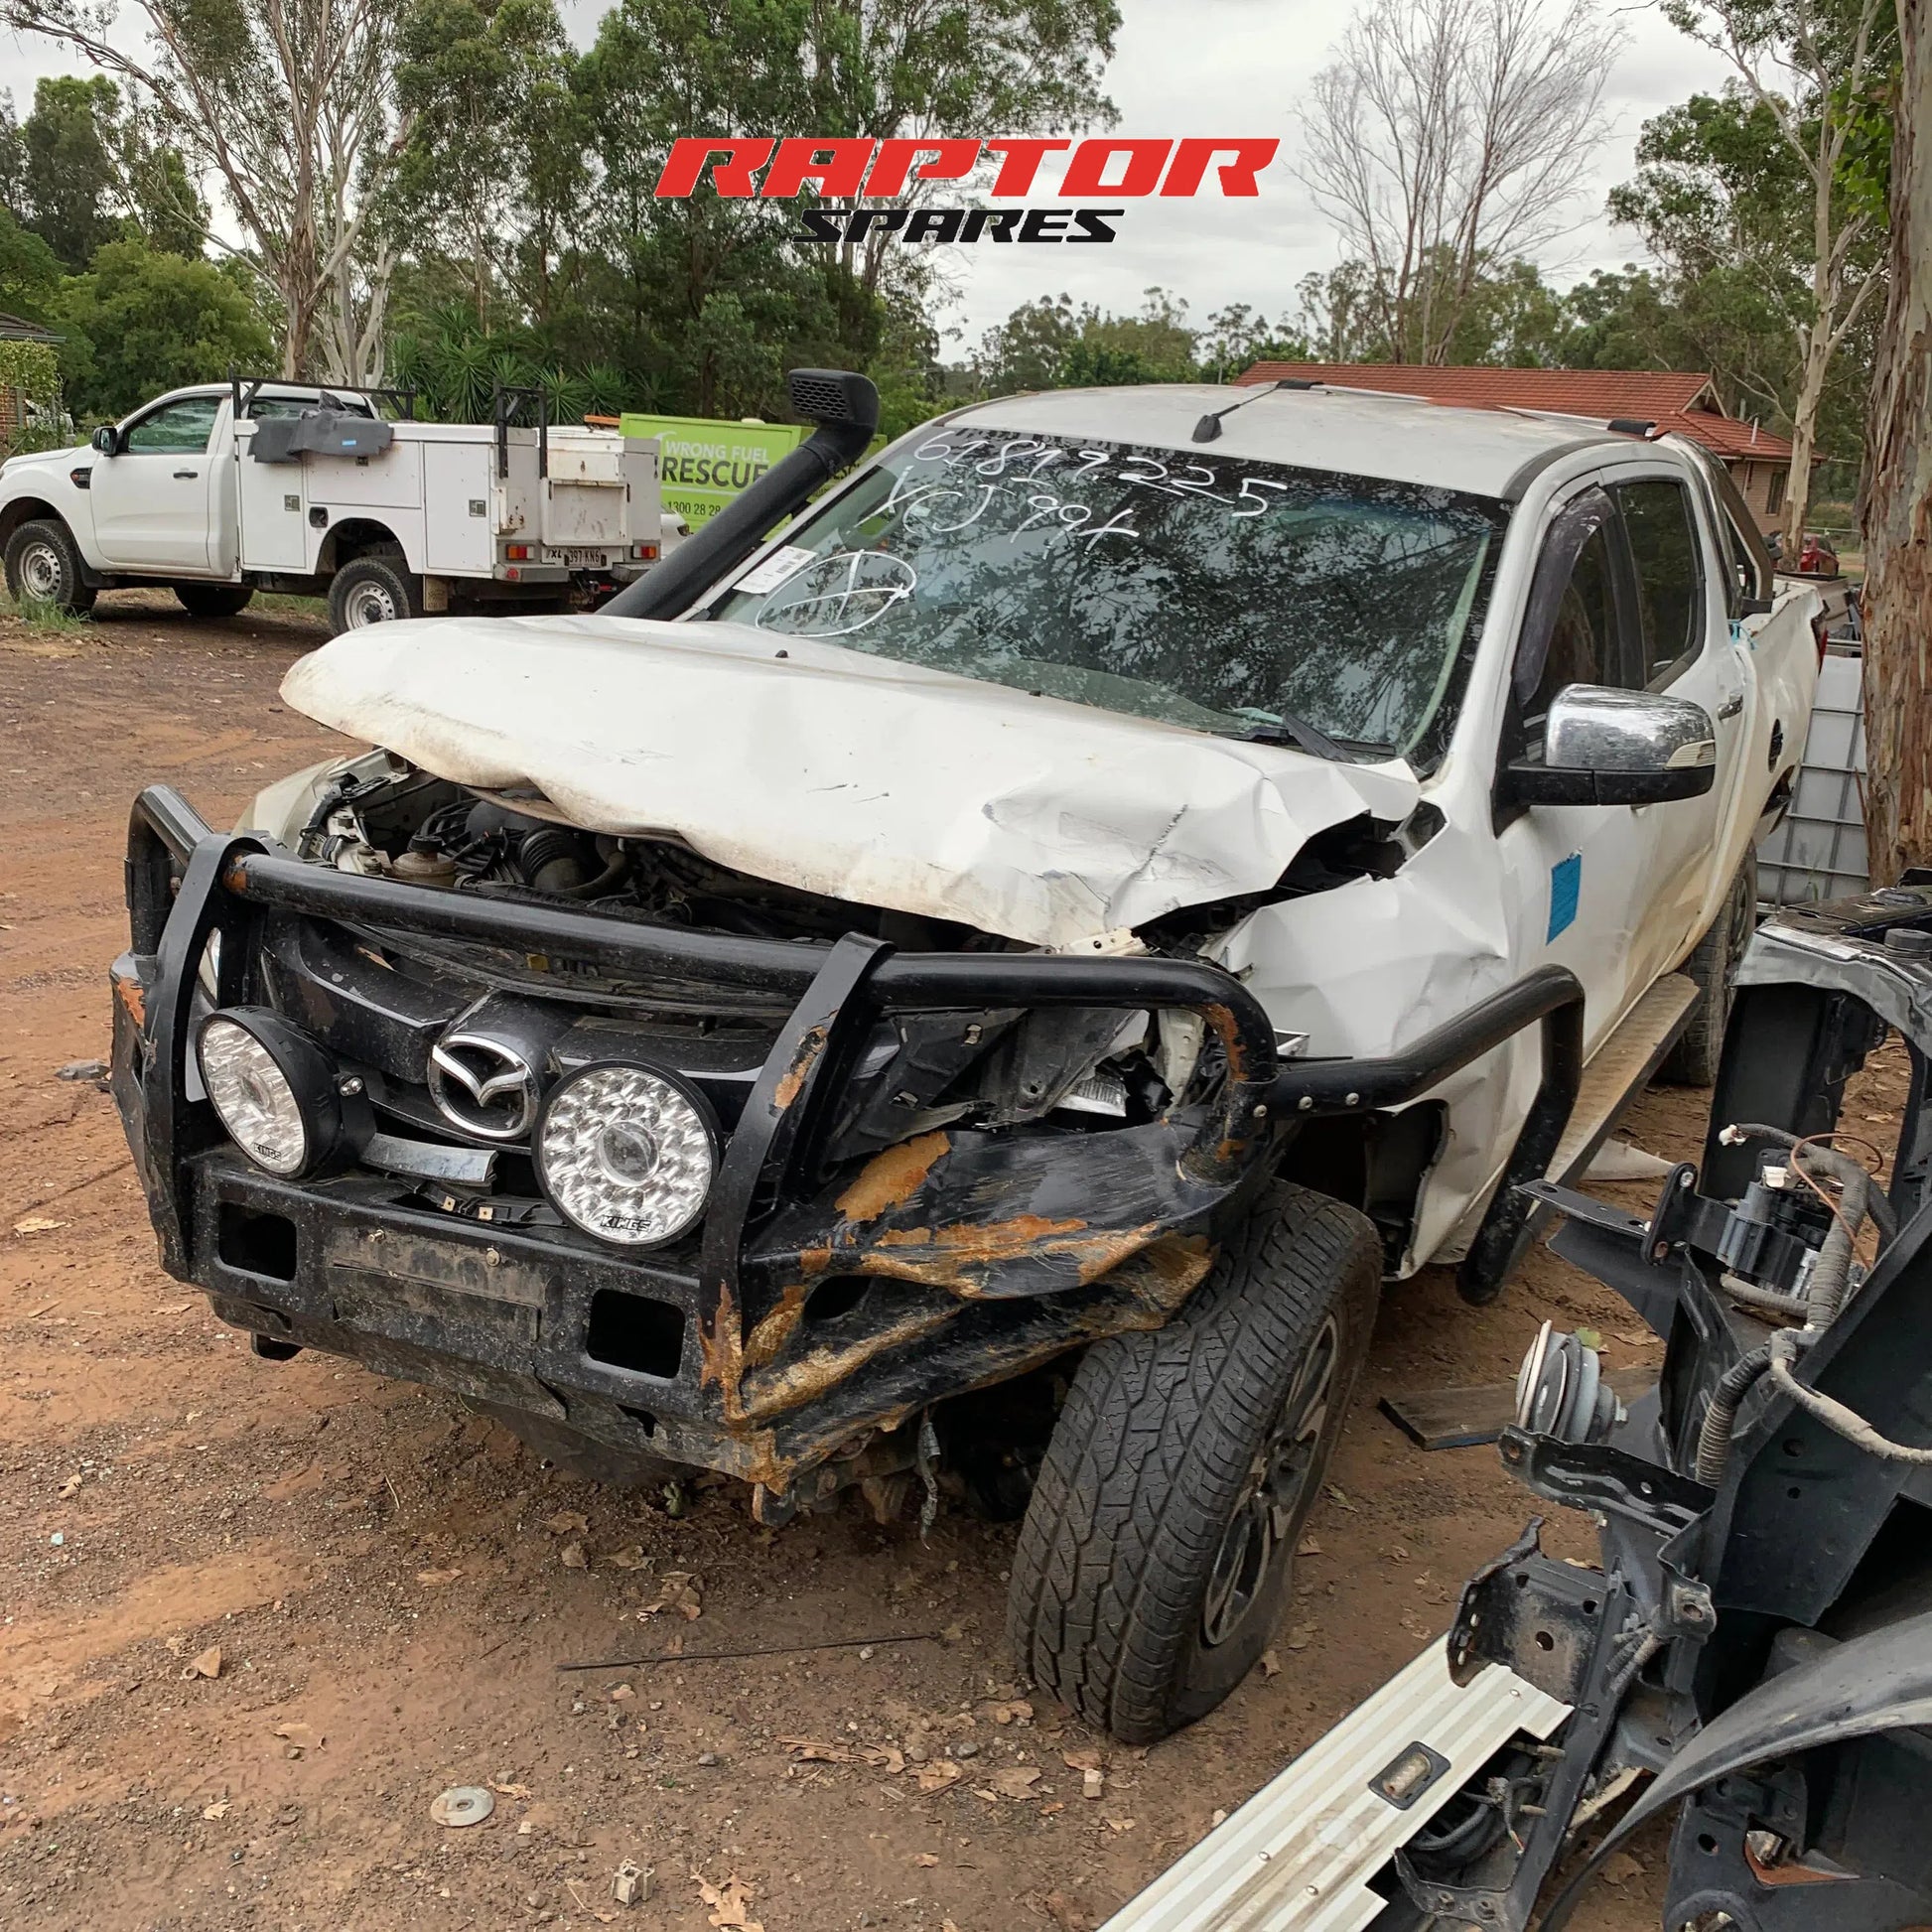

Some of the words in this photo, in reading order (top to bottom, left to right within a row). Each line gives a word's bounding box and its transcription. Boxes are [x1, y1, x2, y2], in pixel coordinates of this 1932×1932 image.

[666, 440, 727, 461] WRONG
[732, 445, 769, 464] FUEL
[667, 500, 691, 514] 1300
[694, 502, 706, 516] 28
[600, 1215, 652, 1232] KINGS
